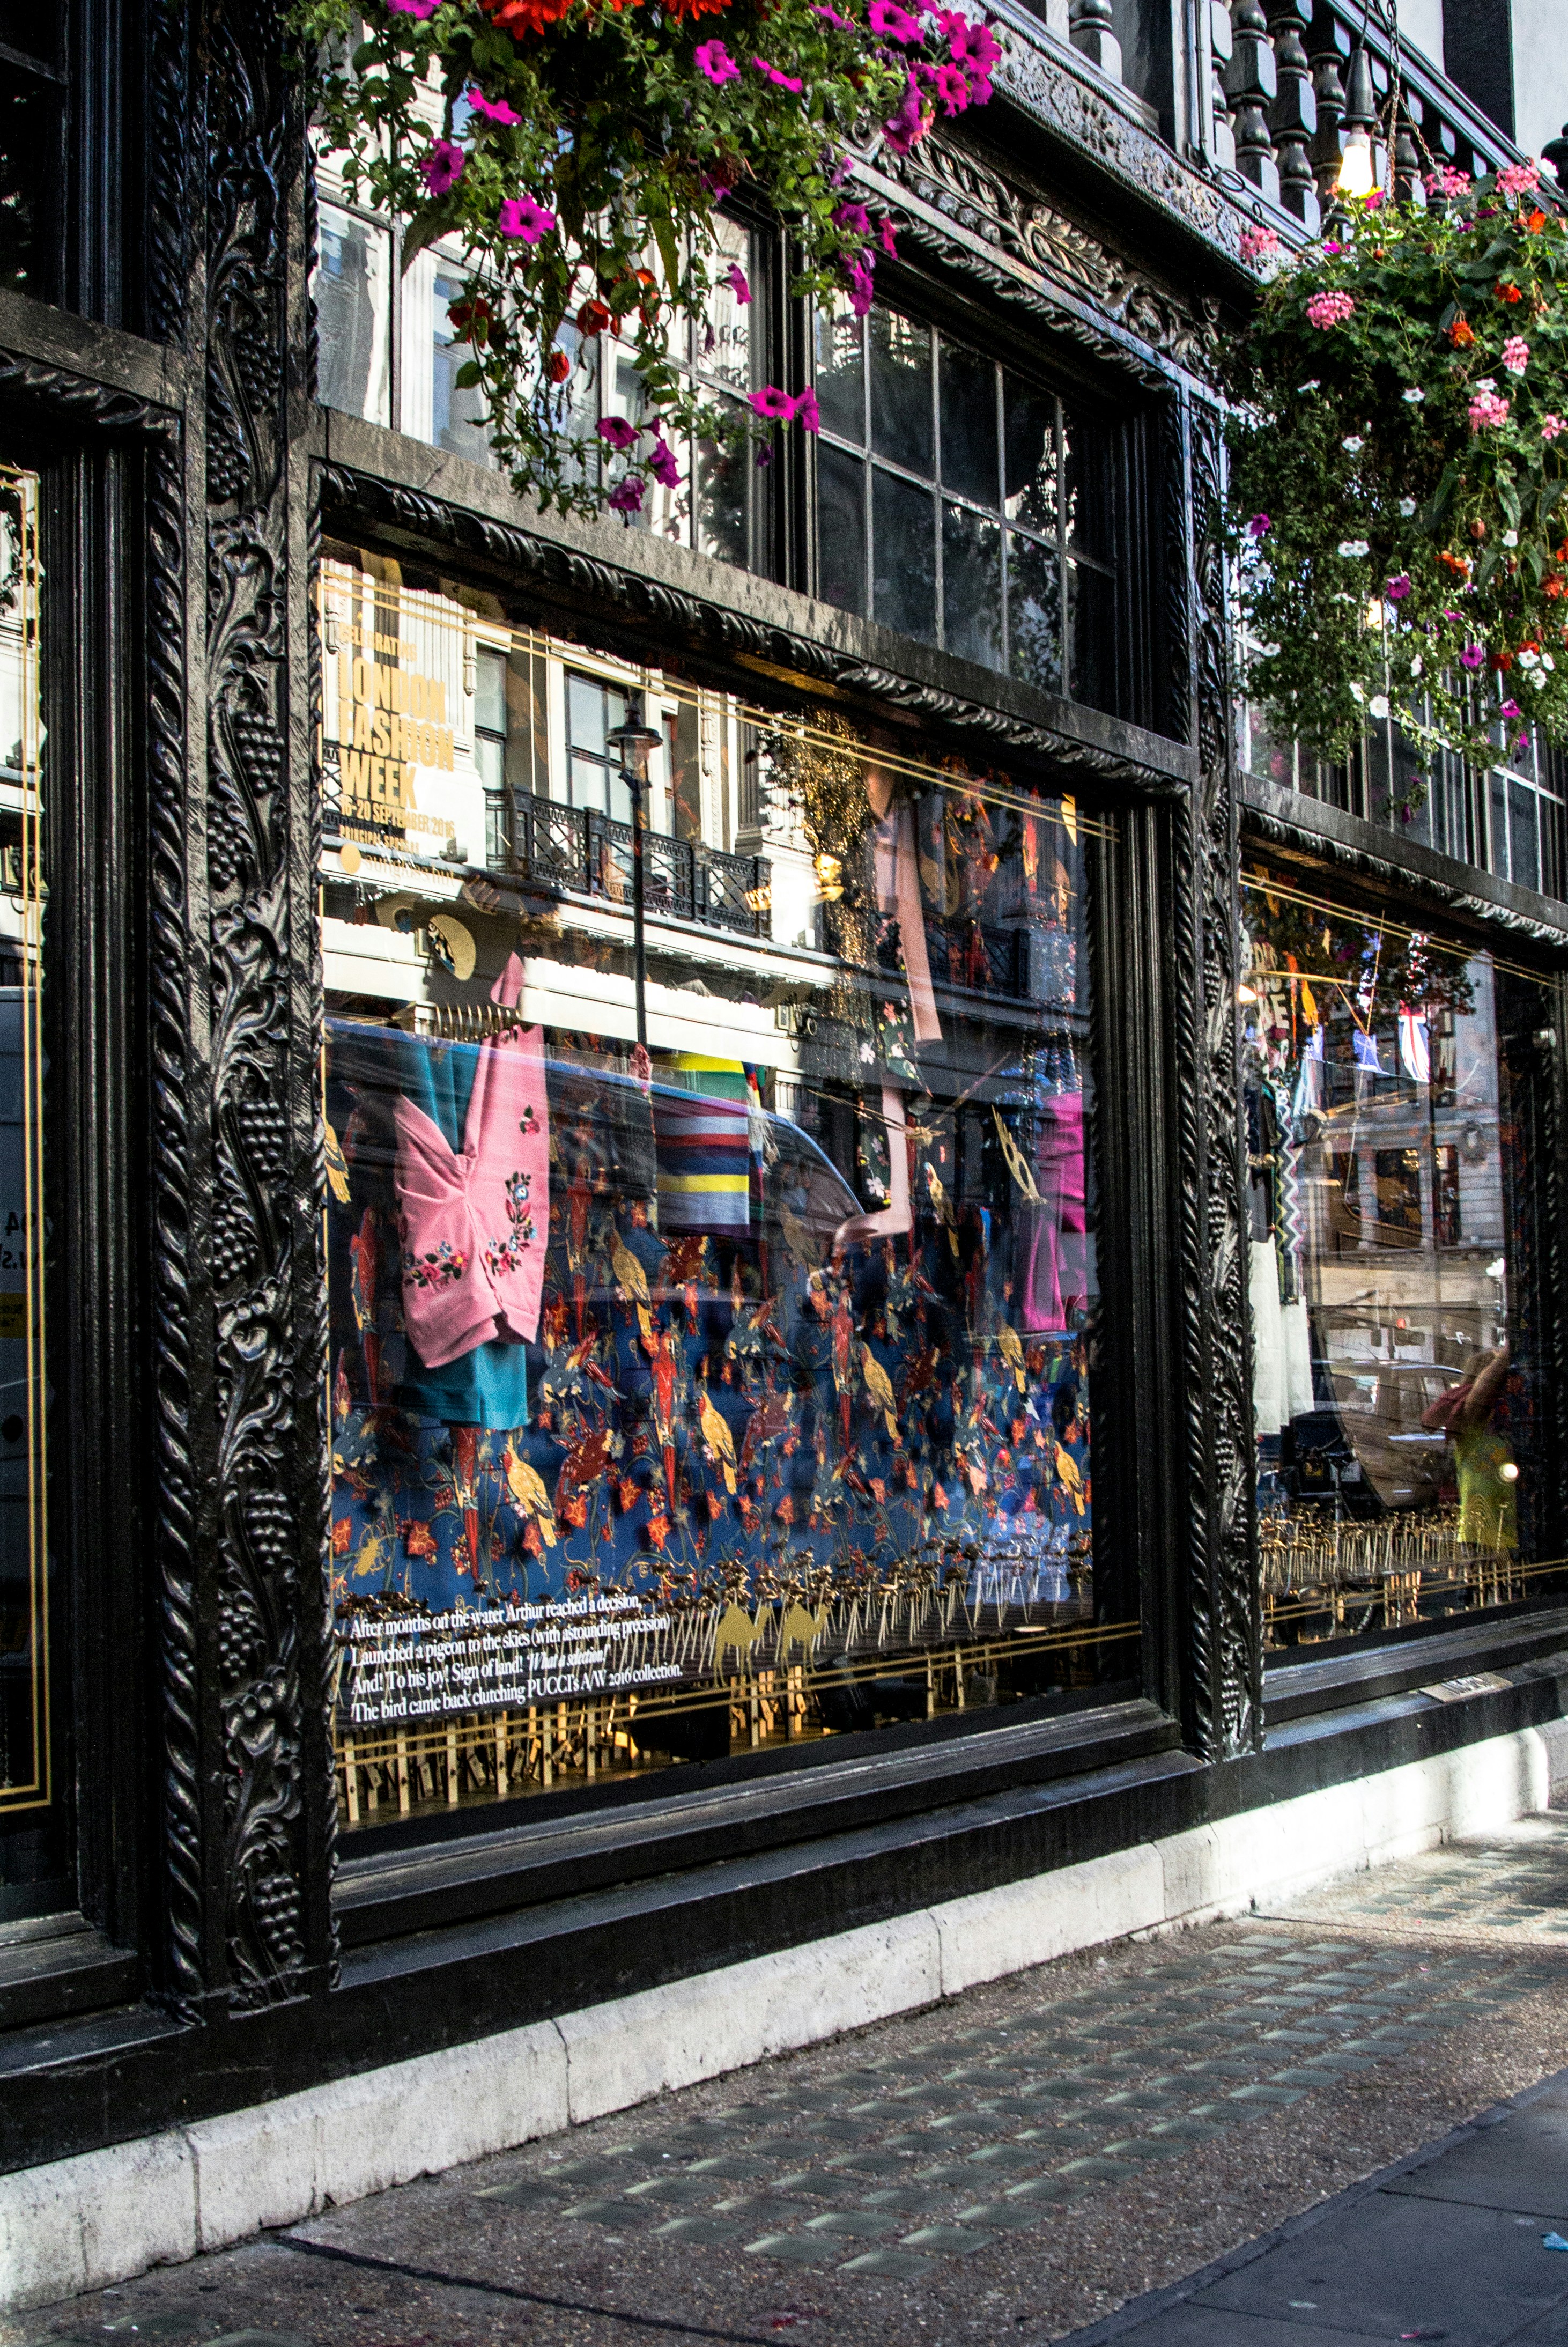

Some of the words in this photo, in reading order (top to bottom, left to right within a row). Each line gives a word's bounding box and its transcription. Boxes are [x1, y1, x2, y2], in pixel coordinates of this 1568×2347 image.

[338, 622, 417, 662] CELEBRATING
[338, 652, 446, 724] LONDON
[339, 699, 454, 773] FASHION
[339, 747, 417, 810] WEEK
[339, 794, 371, 821] 16-20
[372, 802, 429, 833] SEPTEMBER
[431, 816, 455, 839] 2016
[432, 863, 455, 887] hut
[350, 1618, 383, 1639] After
[385, 1613, 431, 1635] months
[432, 1615, 449, 1630] on
[451, 1609, 470, 1628] the
[470, 1609, 505, 1625] water
[506, 1602, 544, 1622] Arthur
[545, 1596, 587, 1618] reached
[589, 1599, 596, 1612] a
[597, 1593, 642, 1612] decision,
[351, 1641, 413, 1666] Launched
[415, 1644, 424, 1659] a
[425, 1639, 466, 1663] pigeon
[468, 1637, 481, 1652] to
[482, 1633, 501, 1651] the
[502, 1629, 530, 1649] skies
[531, 1625, 561, 1647] (with
[562, 1619, 621, 1641] astounding
[622, 1612, 670, 1639] precision)
[351, 1673, 383, 1695] And!
[385, 1670, 406, 1690] To
[407, 1668, 426, 1688] his
[426, 1664, 449, 1691] joy!
[452, 1662, 479, 1685] Sign
[481, 1658, 495, 1678] of
[494, 1655, 523, 1676] land!
[558, 1654, 566, 1668] a
[351, 1702, 379, 1722] The
[380, 1697, 407, 1719] bird
[409, 1697, 441, 1715] came
[442, 1689, 471, 1710] back
[472, 1683, 526, 1706] clutching
[527, 1674, 580, 1699] PUCCI's
[581, 1669, 608, 1691] A/W
[609, 1666, 632, 1686] 2016
[633, 1662, 683, 1682] collection.
